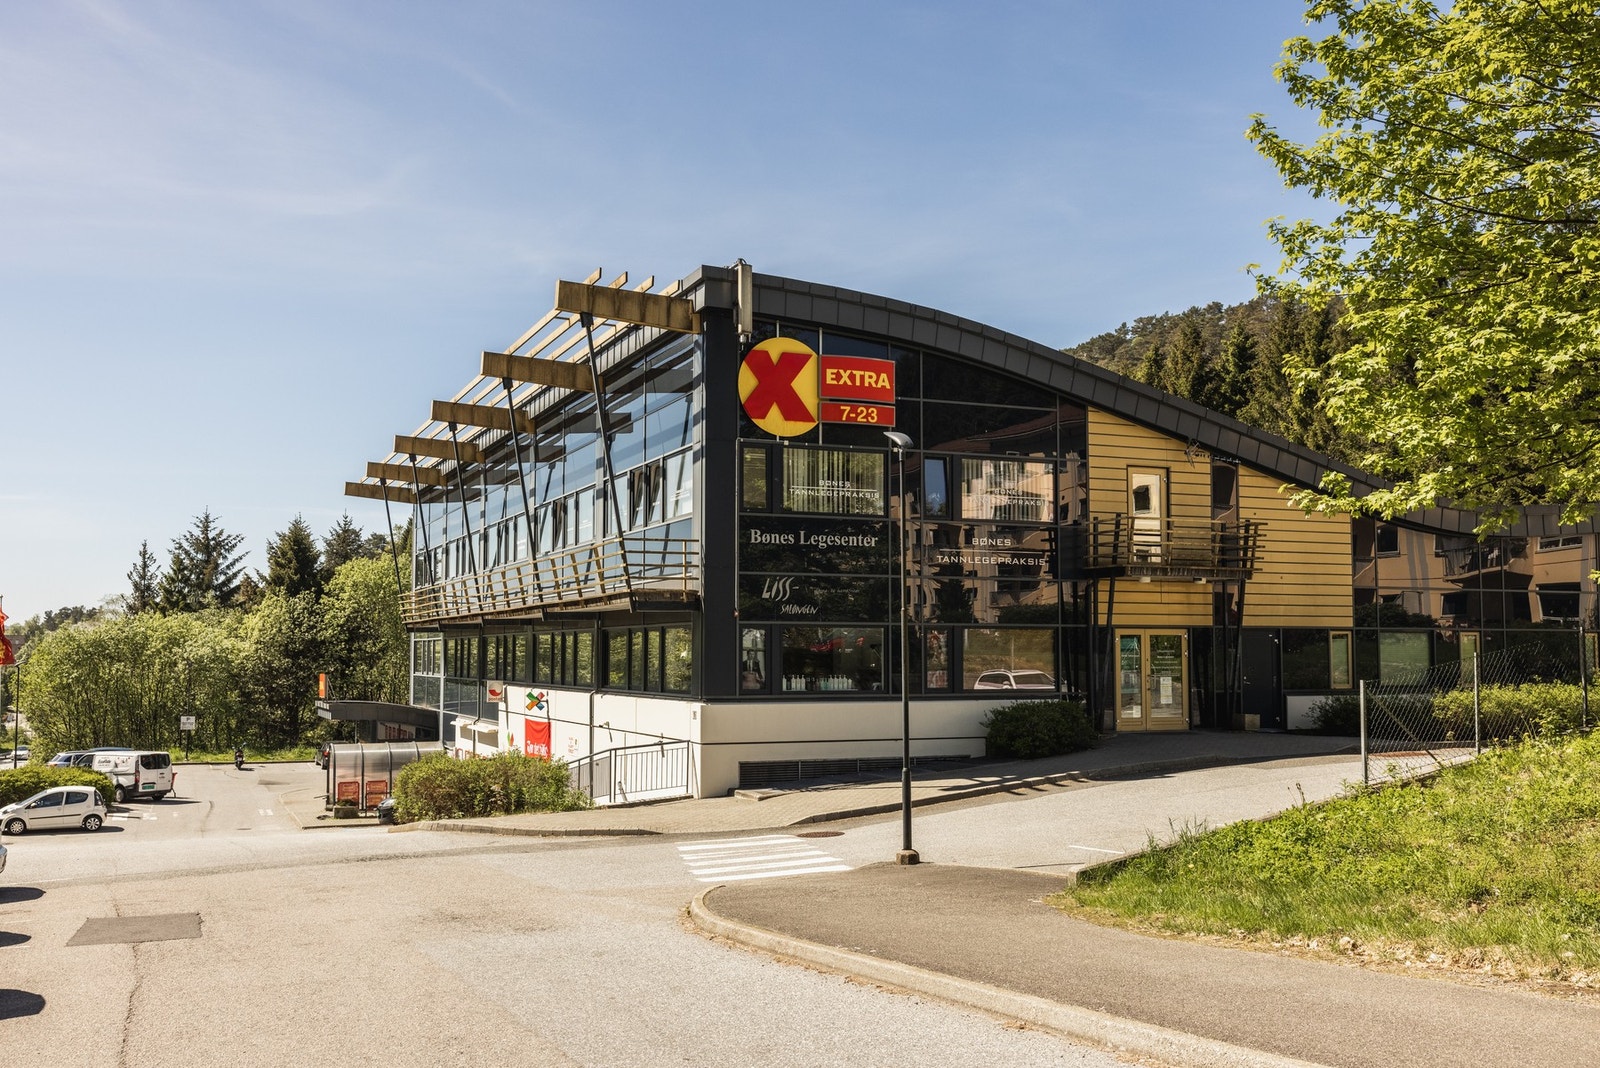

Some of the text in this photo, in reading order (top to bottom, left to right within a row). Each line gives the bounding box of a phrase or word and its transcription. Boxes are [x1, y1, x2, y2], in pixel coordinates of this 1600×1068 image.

[825, 368, 891, 389] EXTRA
[840, 405, 878, 423] 7-23
[789, 488, 880, 499] TANNLEGEPRAKSIS
[750, 528, 879, 549] Bønes Legesenter
[971, 536, 1012, 547] BØNES
[936, 555, 1047, 566] TANNLEGEPRAKSIS
